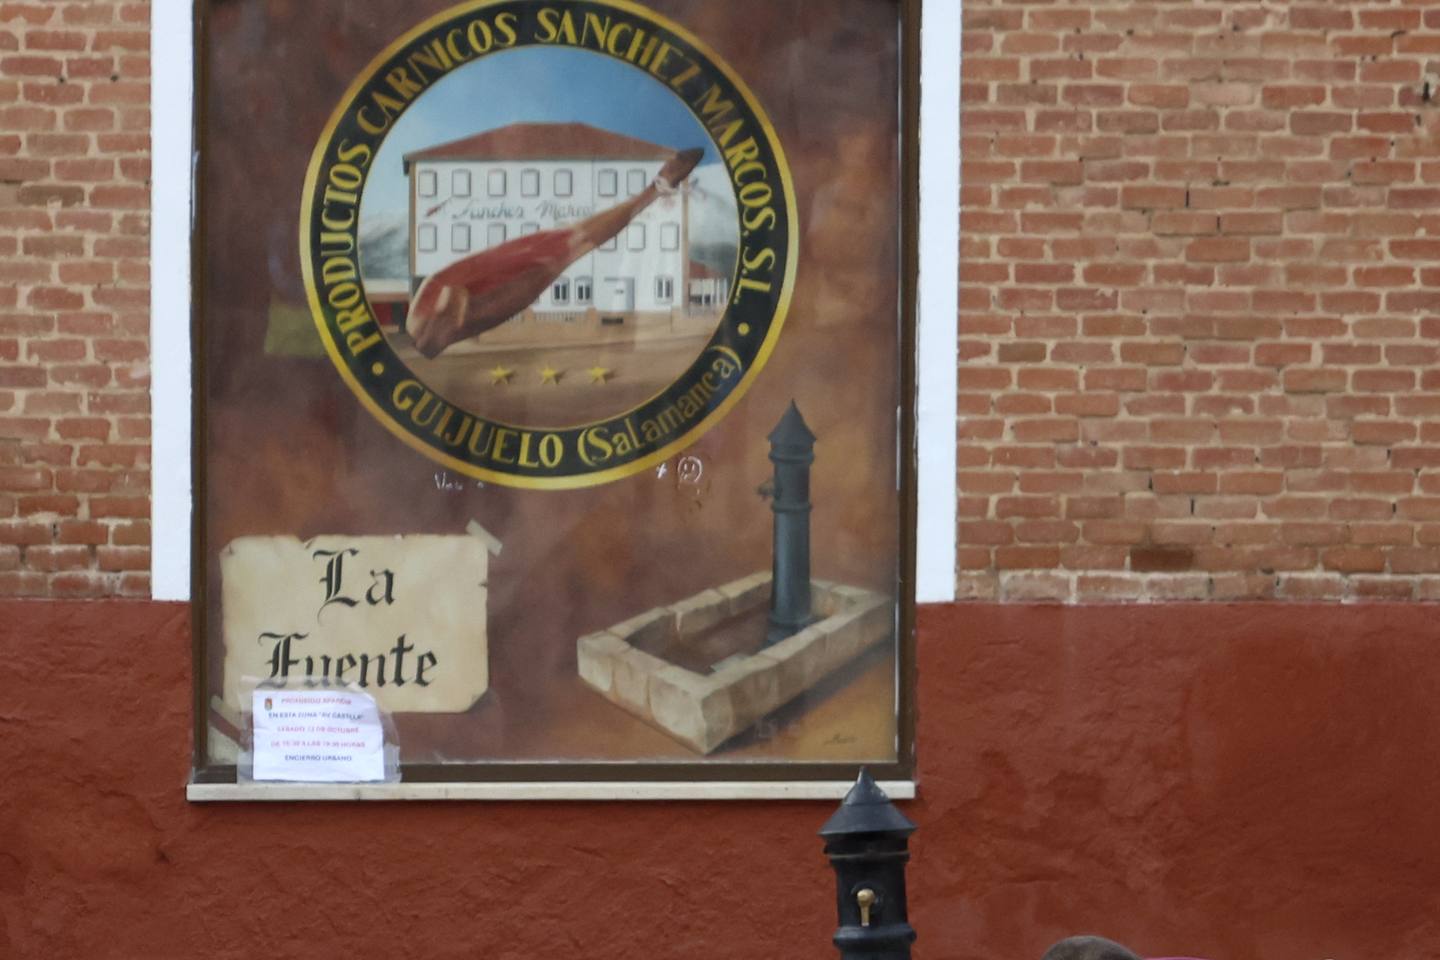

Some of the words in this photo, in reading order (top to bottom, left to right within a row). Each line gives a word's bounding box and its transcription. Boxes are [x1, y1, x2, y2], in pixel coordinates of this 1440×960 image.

[320, 139, 382, 357] PRODUCTOS
[356, 12, 518, 135] CARNICOS
[533, 7, 702, 91] SANCHEZ
[392, 379, 564, 469] GUIJUELO
[577, 345, 742, 467] (Salamanca)
[312, 546, 395, 624] La
[256, 631, 438, 689] Fuente
